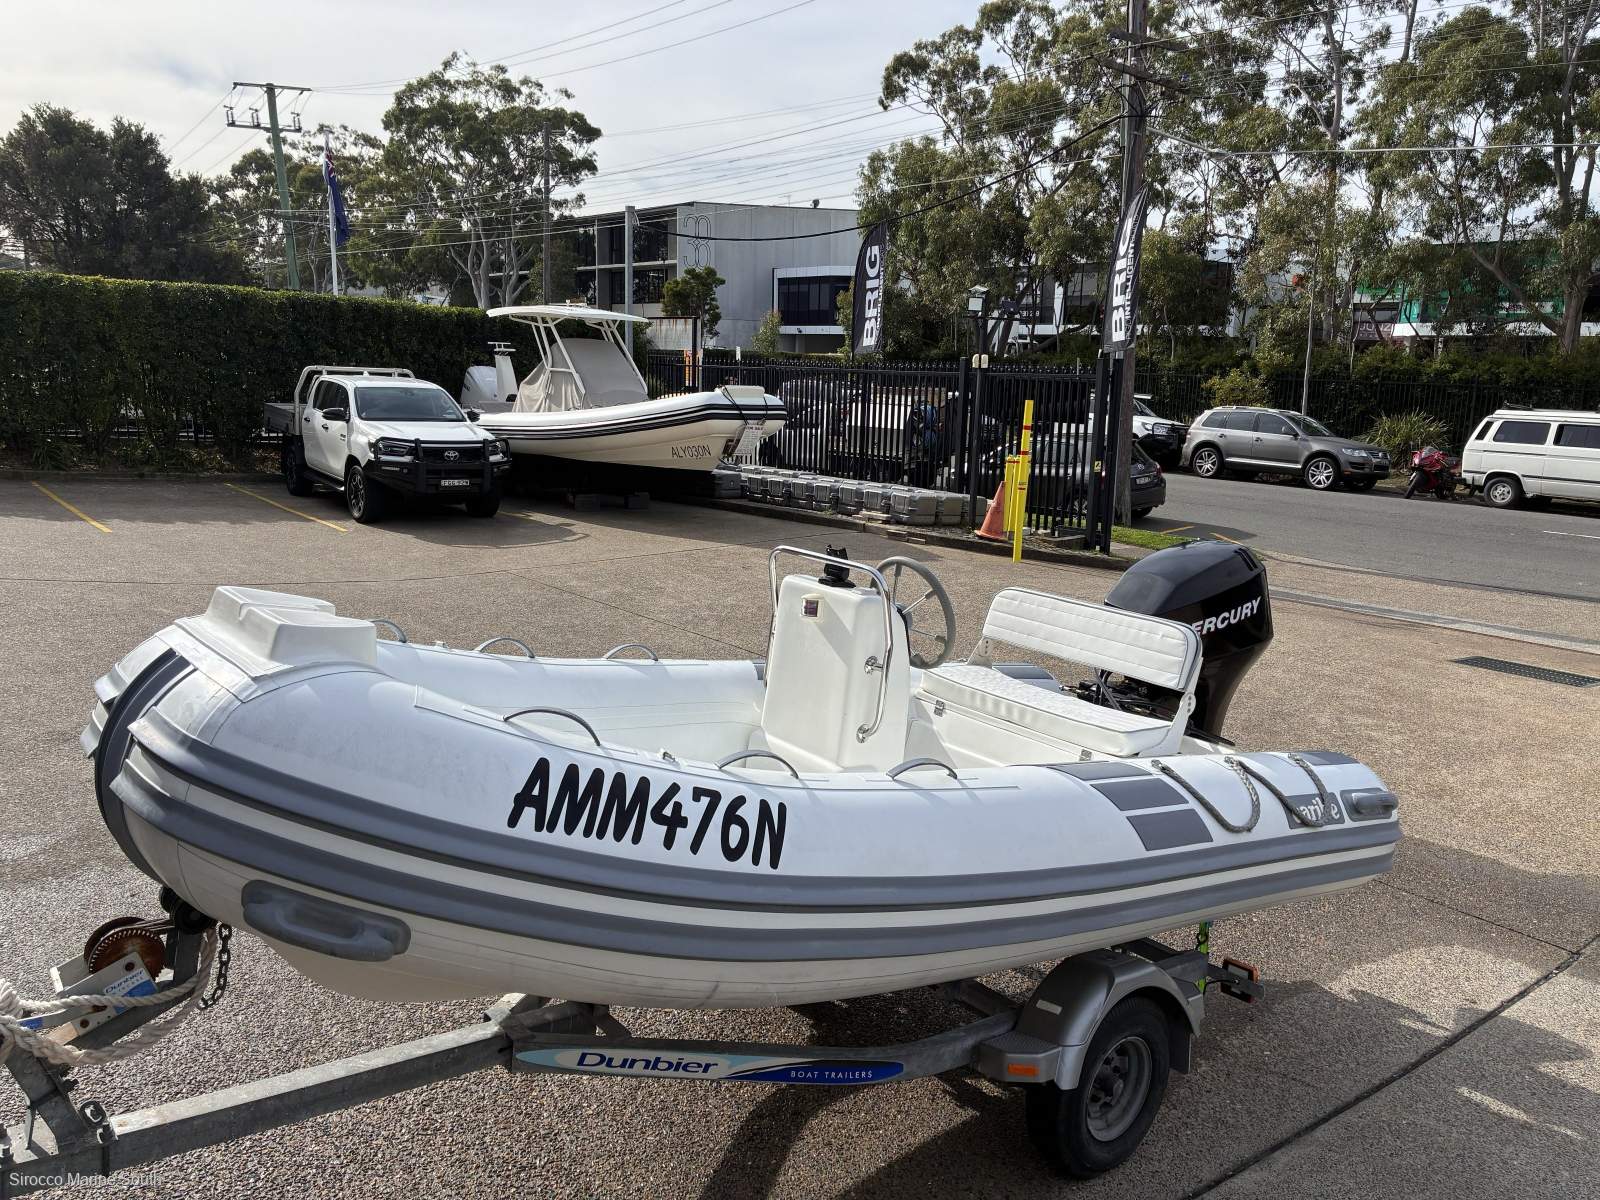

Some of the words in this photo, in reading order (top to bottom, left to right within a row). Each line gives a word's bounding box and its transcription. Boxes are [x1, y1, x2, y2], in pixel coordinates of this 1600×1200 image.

[683, 213, 712, 271] 38
[863, 245, 880, 347] BRIG
[671, 444, 712, 458] ALY030N
[1191, 595, 1262, 636] ERCURY
[507, 757, 787, 870] AMM476N
[576, 1051, 718, 1074] Dunbier
[790, 1070, 818, 1079] BOAT
[824, 1070, 873, 1079] TRAILERS
